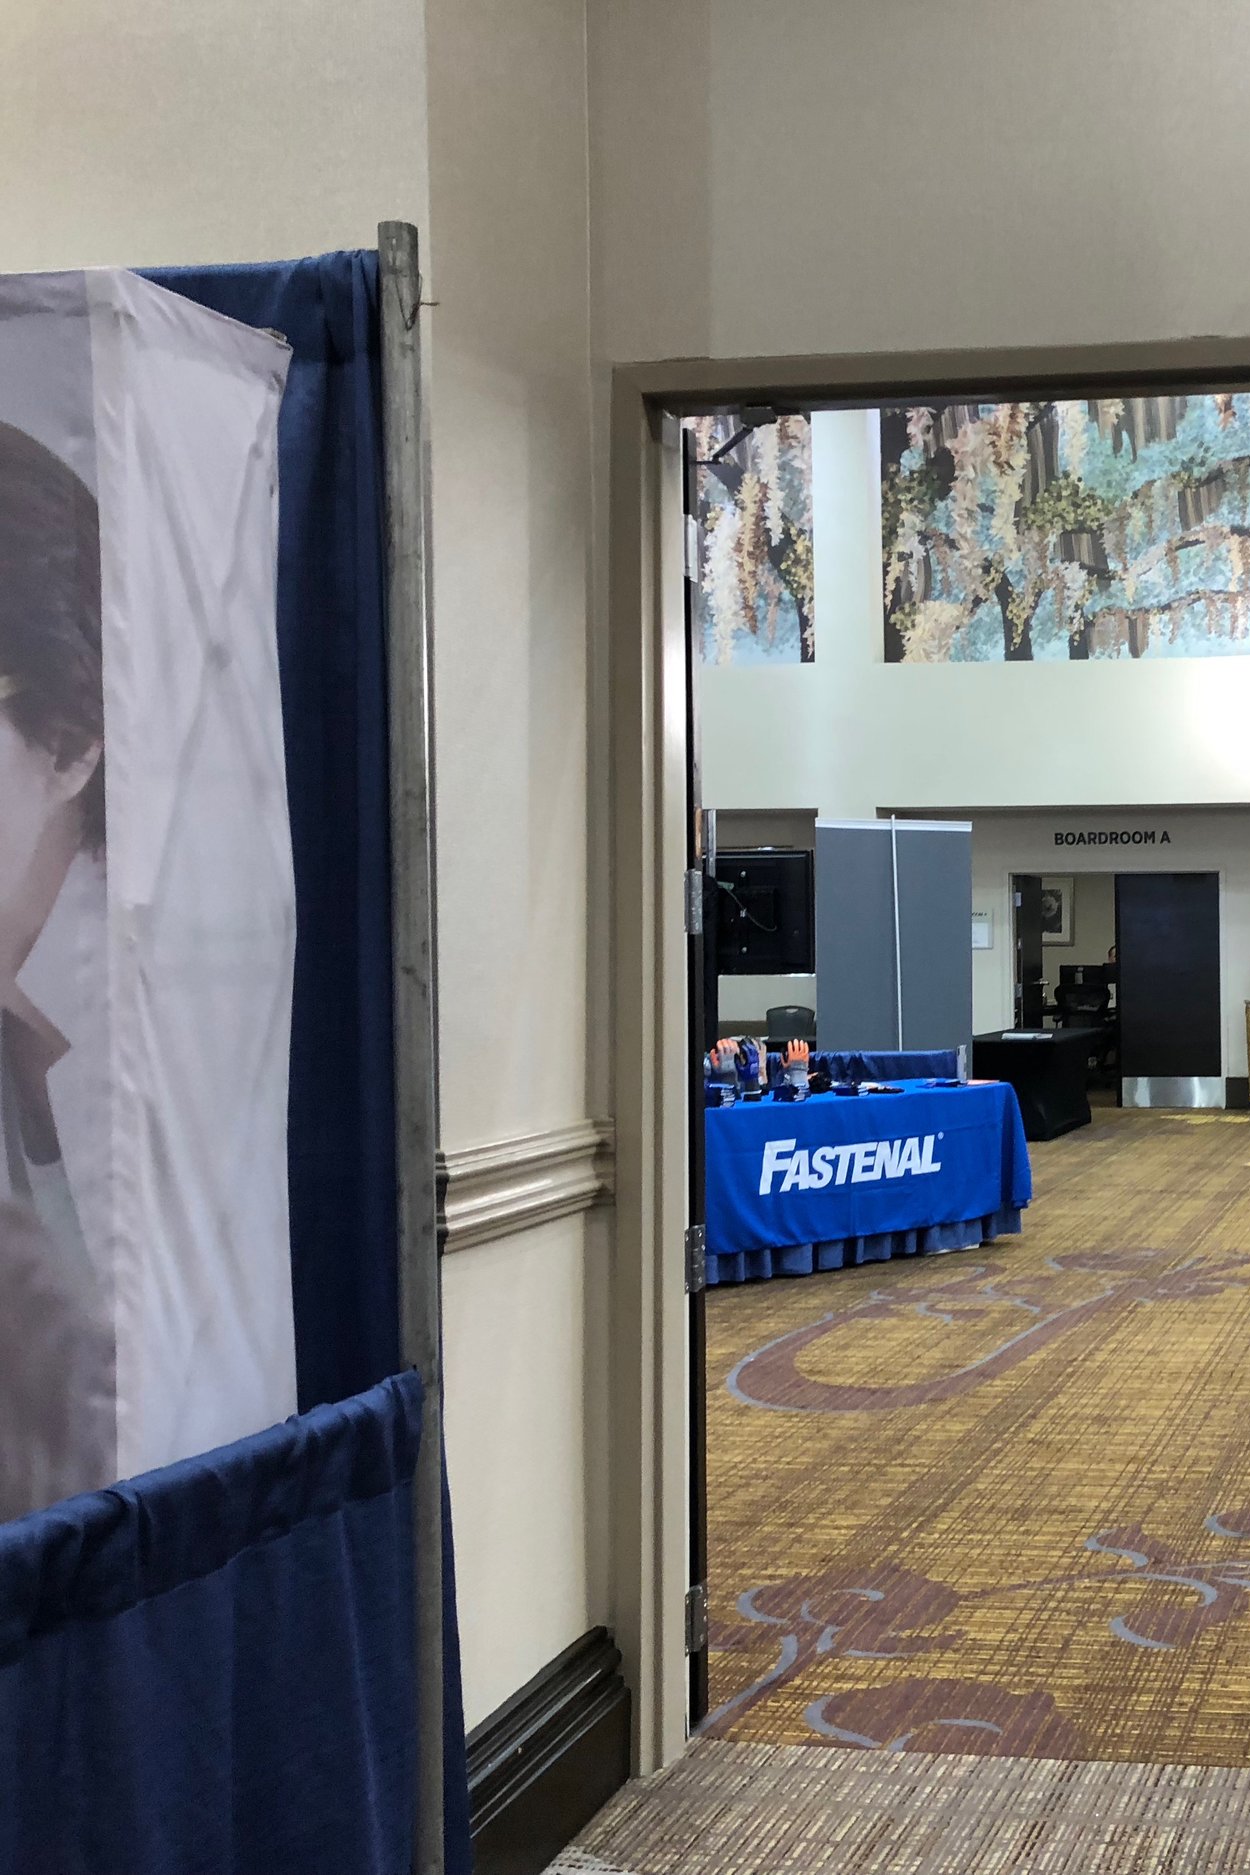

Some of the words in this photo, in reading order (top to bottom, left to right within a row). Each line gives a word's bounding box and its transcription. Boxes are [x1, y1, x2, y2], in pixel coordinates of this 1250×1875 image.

[1054, 831, 1156, 846] BOARDROOM
[1160, 830, 1171, 844] A
[759, 1133, 942, 1196] FASTENAL
